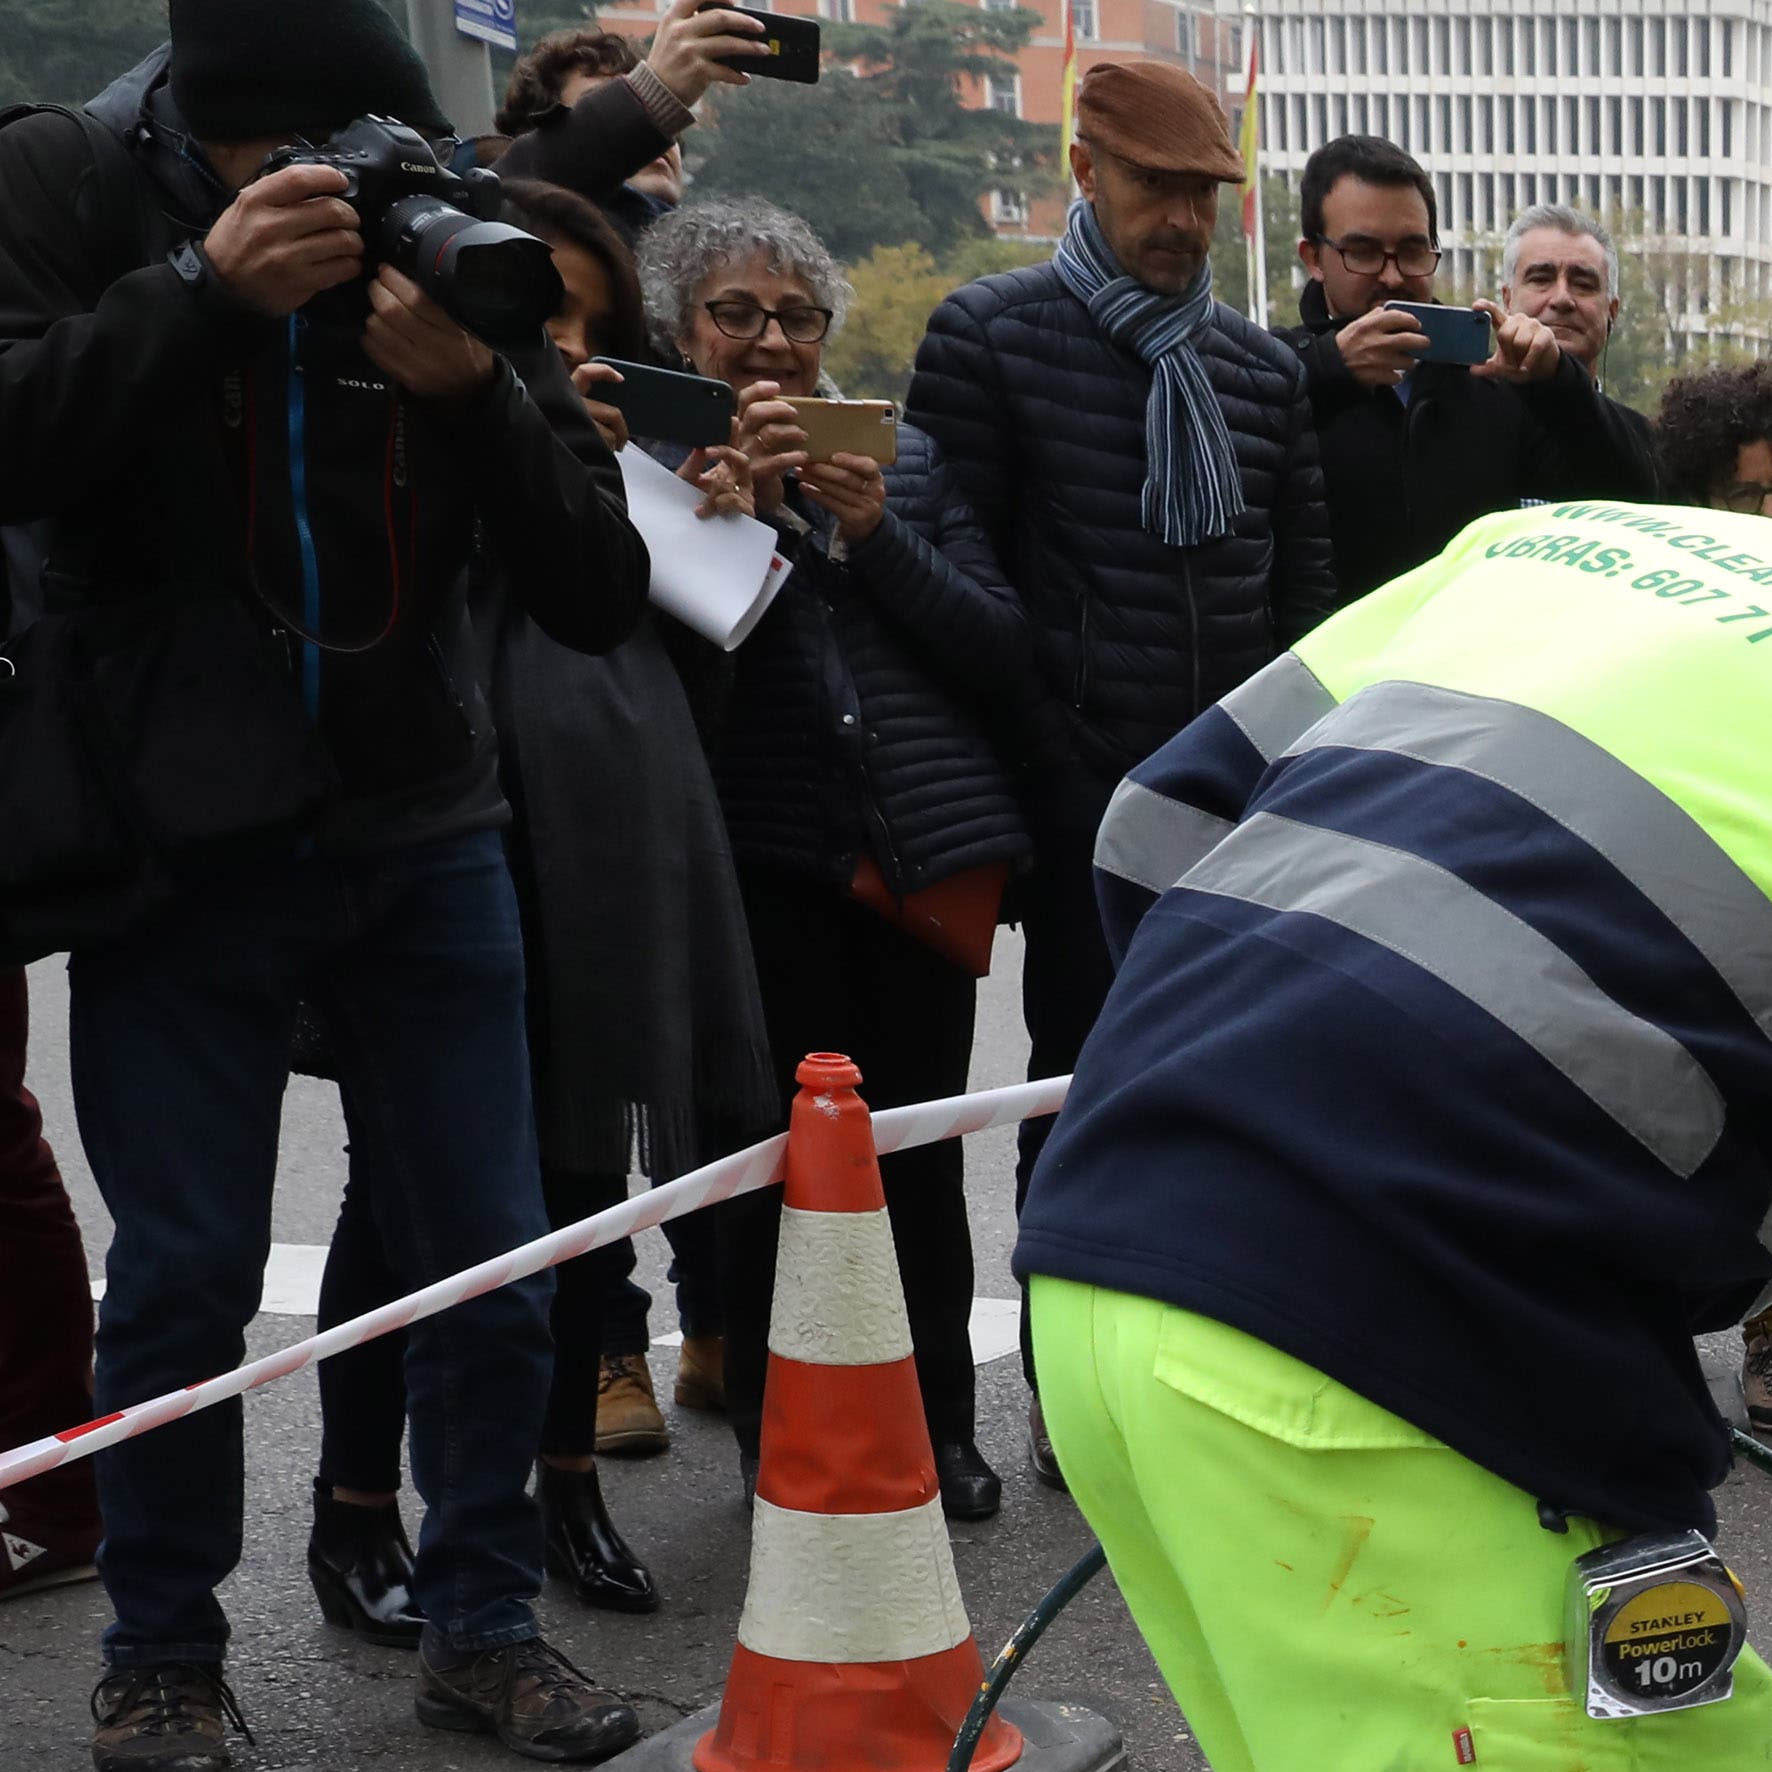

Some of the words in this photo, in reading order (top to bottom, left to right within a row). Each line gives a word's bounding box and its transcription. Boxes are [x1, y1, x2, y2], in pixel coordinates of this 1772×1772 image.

[400, 161, 436, 174] Canon
[1485, 534, 1634, 577] OBRAS:
[1631, 569, 1731, 605] 607
[1630, 1611, 1706, 1634] STANLEY
[1619, 1630, 1716, 1660] PowerLock
